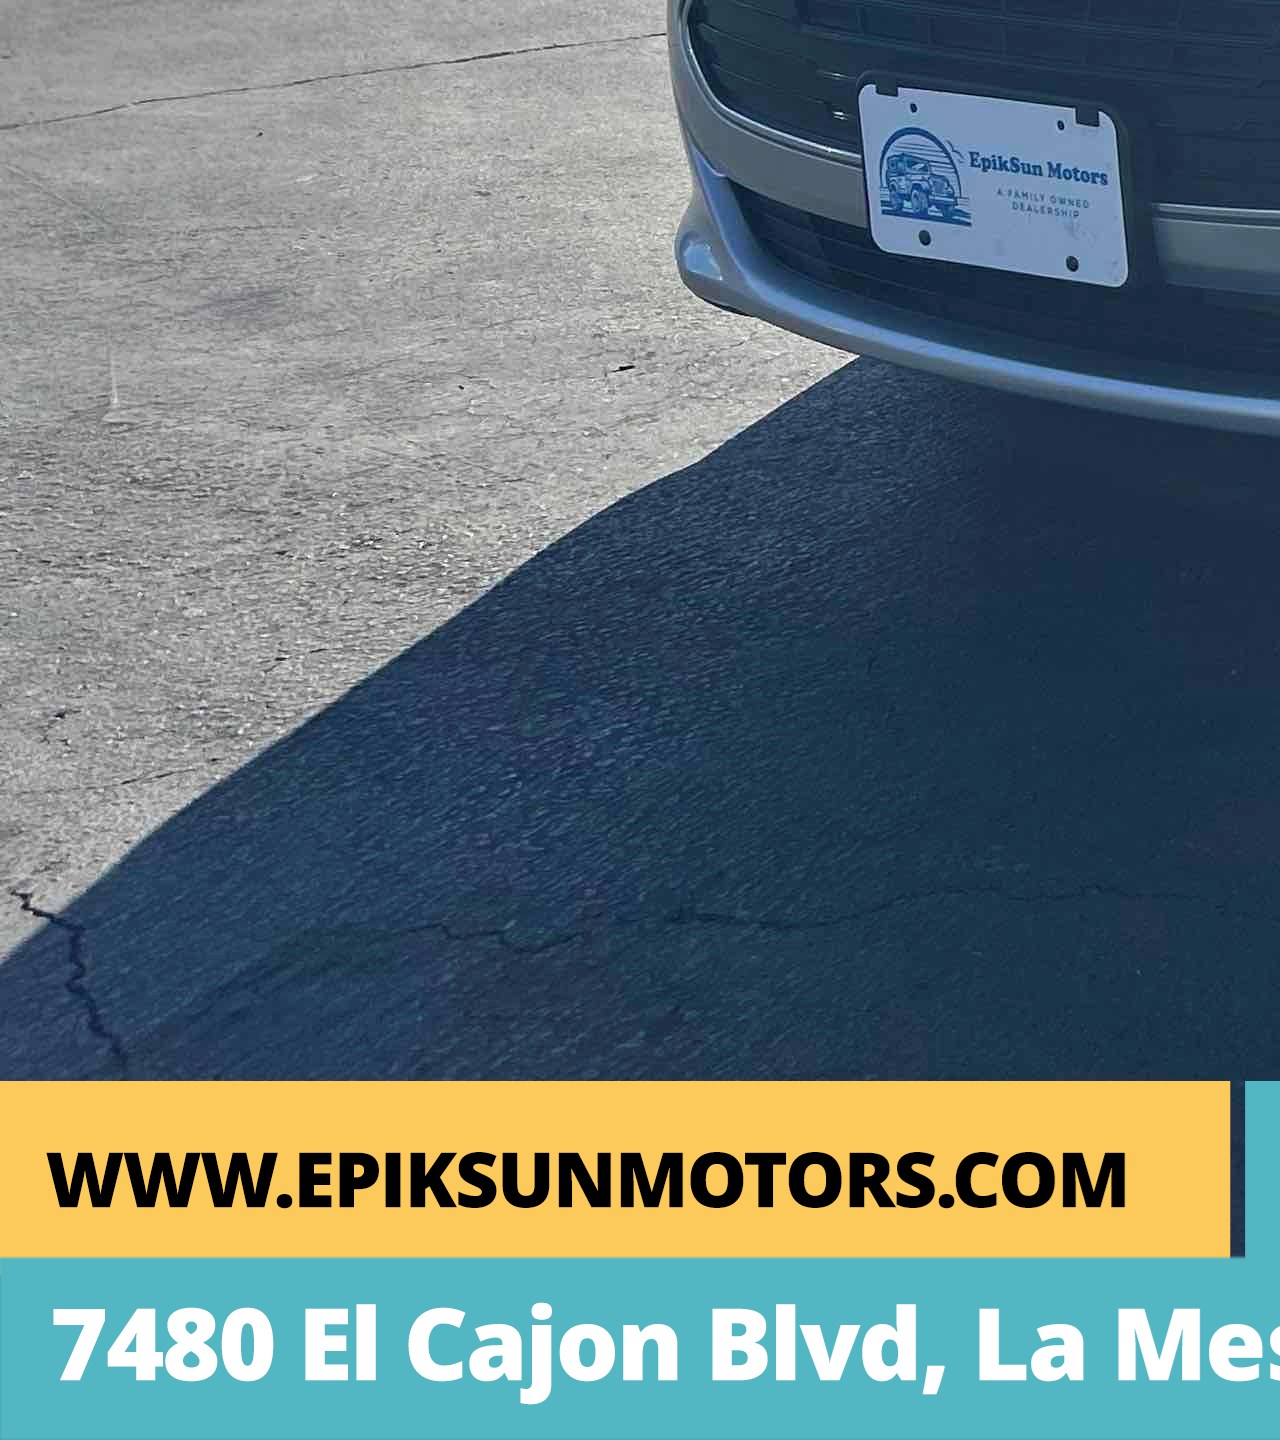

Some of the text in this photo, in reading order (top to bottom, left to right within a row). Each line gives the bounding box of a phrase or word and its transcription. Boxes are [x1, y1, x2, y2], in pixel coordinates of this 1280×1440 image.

[969, 151, 1109, 186] EpikSun Motors
[1008, 190, 1046, 202] FAMILY
[1050, 196, 1090, 209] OWNED
[1012, 203, 1080, 217] DEALERSHIP
